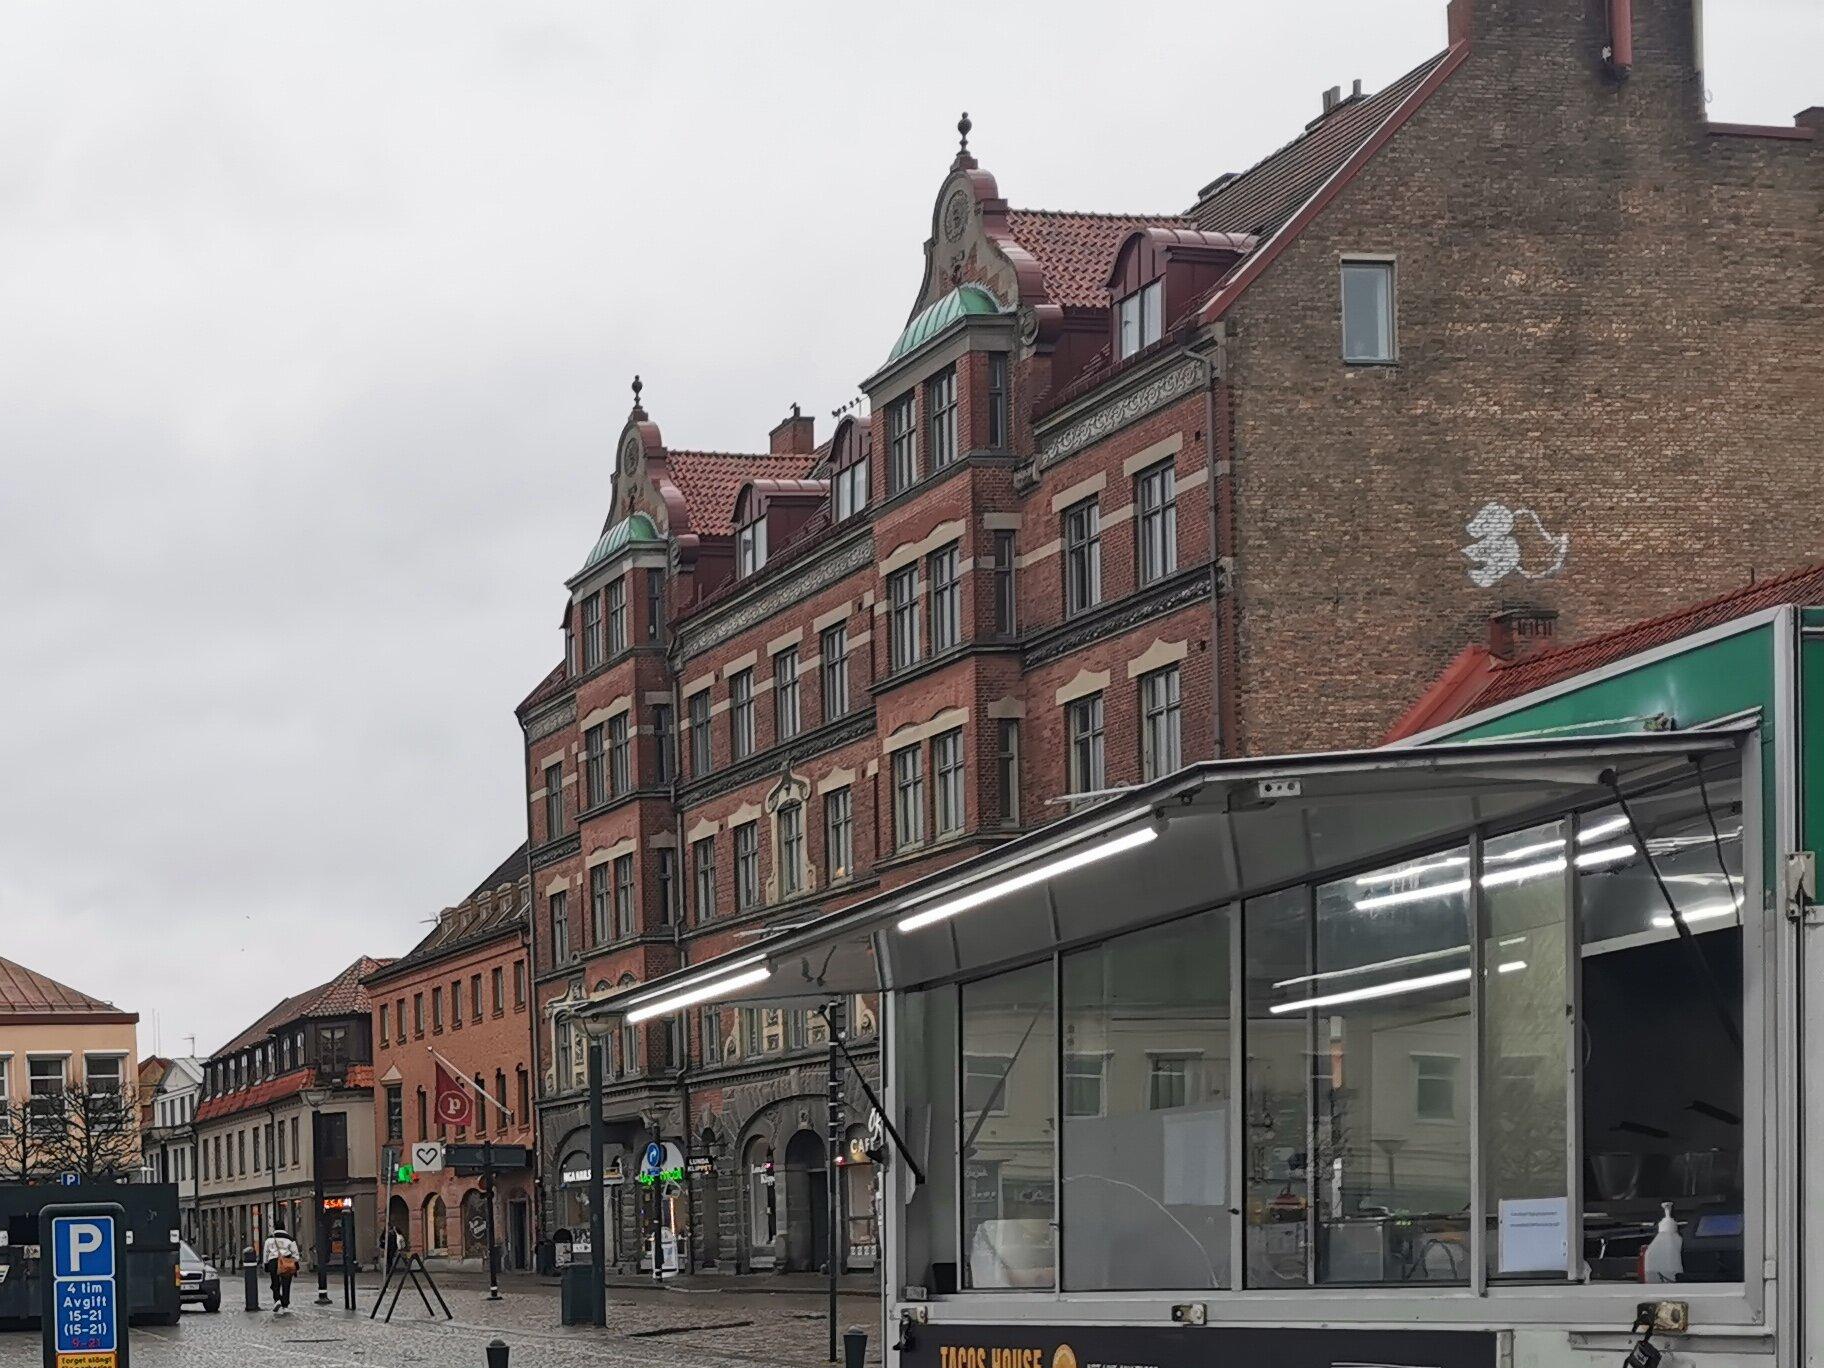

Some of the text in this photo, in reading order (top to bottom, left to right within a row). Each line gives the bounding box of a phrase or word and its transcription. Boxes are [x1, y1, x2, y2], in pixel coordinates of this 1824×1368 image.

[67, 1174, 76, 1186] P
[69, 1224, 102, 1272] P
[67, 1282, 102, 1293] 4 tim
[63, 1296, 107, 1309] Avgift
[69, 1310, 102, 1321] 15-21
[64, 1323, 107, 1336] (15-21)
